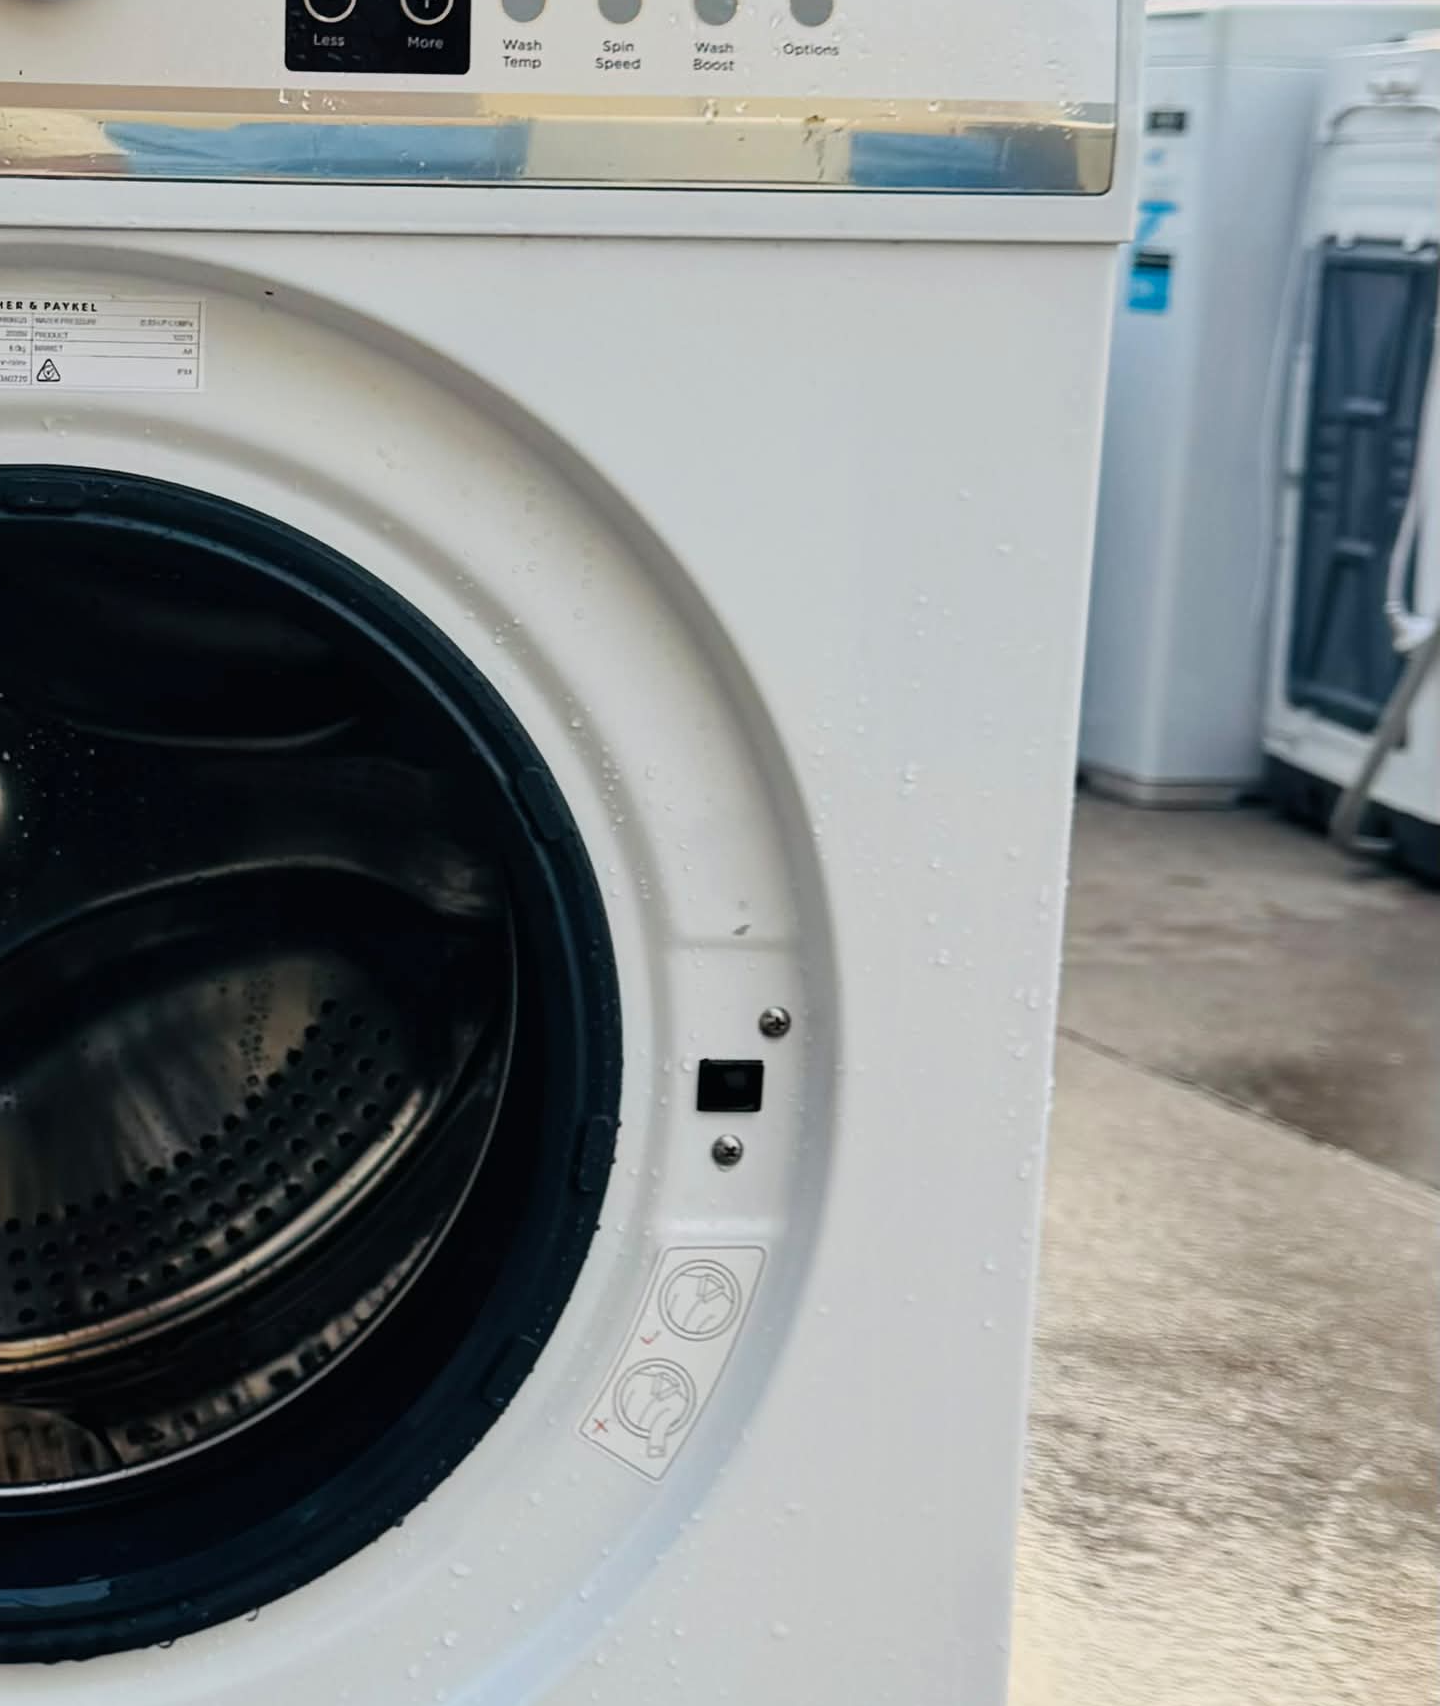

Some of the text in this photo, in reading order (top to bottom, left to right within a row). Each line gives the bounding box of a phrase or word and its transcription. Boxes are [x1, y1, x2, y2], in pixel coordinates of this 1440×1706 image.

[313, 33, 345, 47] Less
[407, 36, 444, 50] More
[502, 38, 542, 51] Wash
[602, 40, 635, 54] Spin
[695, 42, 734, 54] Wash
[783, 43, 840, 57] Options
[502, 55, 542, 70] Temp
[595, 56, 641, 70] Speed
[693, 58, 735, 71] Boost
[29, 301, 38, 310] &
[44, 301, 98, 312] PAYKEL
